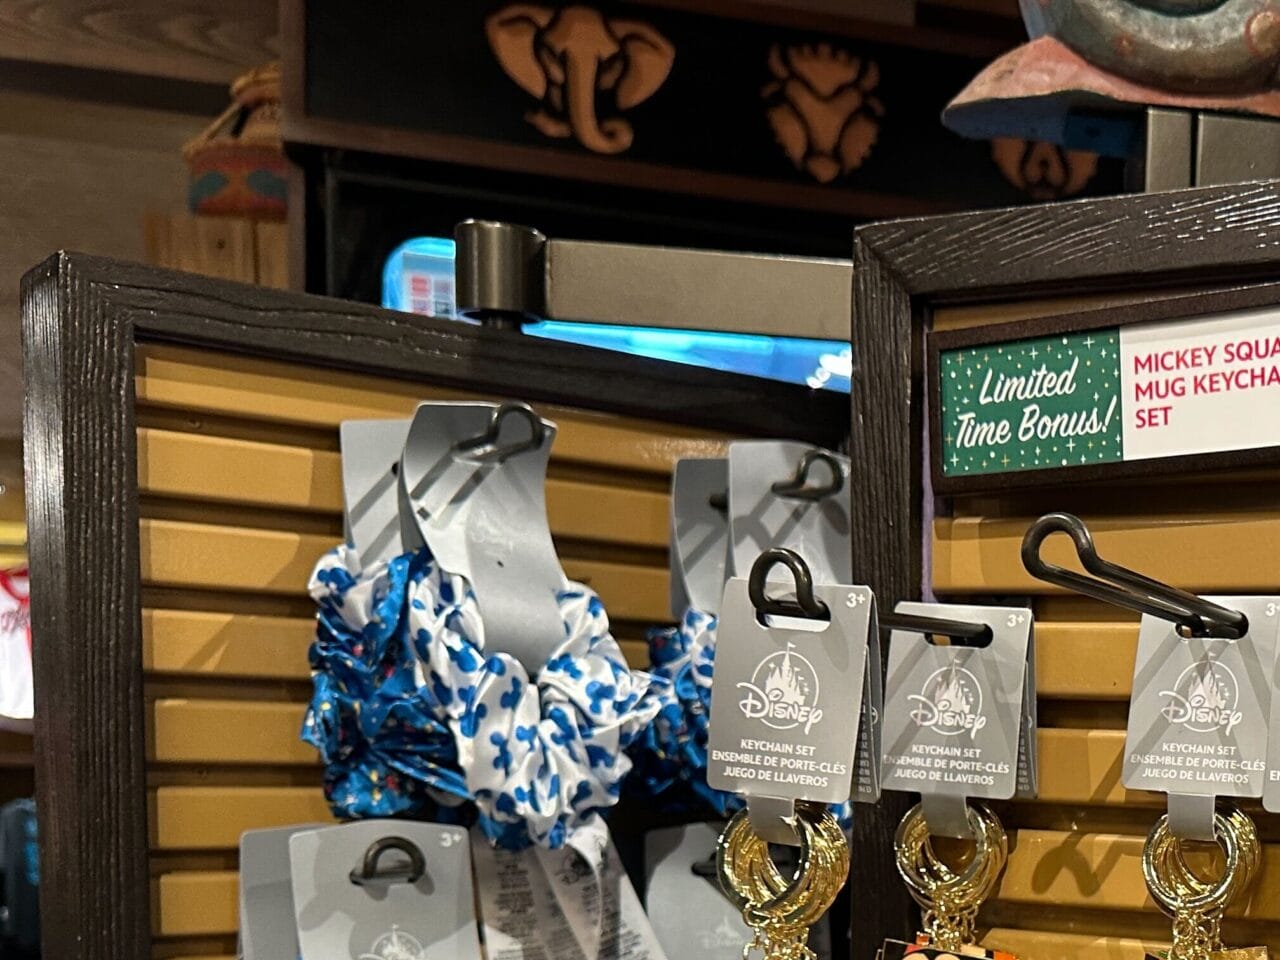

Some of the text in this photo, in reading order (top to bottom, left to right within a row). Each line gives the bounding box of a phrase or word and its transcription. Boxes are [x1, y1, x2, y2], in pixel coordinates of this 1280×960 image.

[1134, 345, 1217, 375] MICKEY
[979, 356, 1079, 405] Limited
[1135, 377, 1185, 402] MUG
[956, 395, 1117, 448] Time Bonus!
[1136, 406, 1172, 428] SET
[846, 592, 866, 608] 3+
[1007, 614, 1025, 627] 3+
[736, 682, 823, 735] Disney
[907, 695, 986, 739] Disney
[1158, 691, 1243, 736] Disney
[740, 739, 816, 756] KEYCHAIN SET
[912, 744, 982, 758] KEYCHAIN SET
[1162, 742, 1236, 755] KEYCHAIN SET
[712, 750, 846, 775] ENSEMBLE DE PORTE-CLÉS
[884, 755, 1009, 773] ENSEMBLE DE PORTE-CLÉS
[1131, 754, 1266, 771] ENSEMBLE DE PORTE-CLÉS
[723, 766, 828, 787] JUEGO DE LLAVEROS
[894, 769, 994, 785] JUEGO DE LLAVEROS
[1142, 768, 1249, 783] JUEGO DE LLAVEROS
[439, 832, 463, 848] 3+
